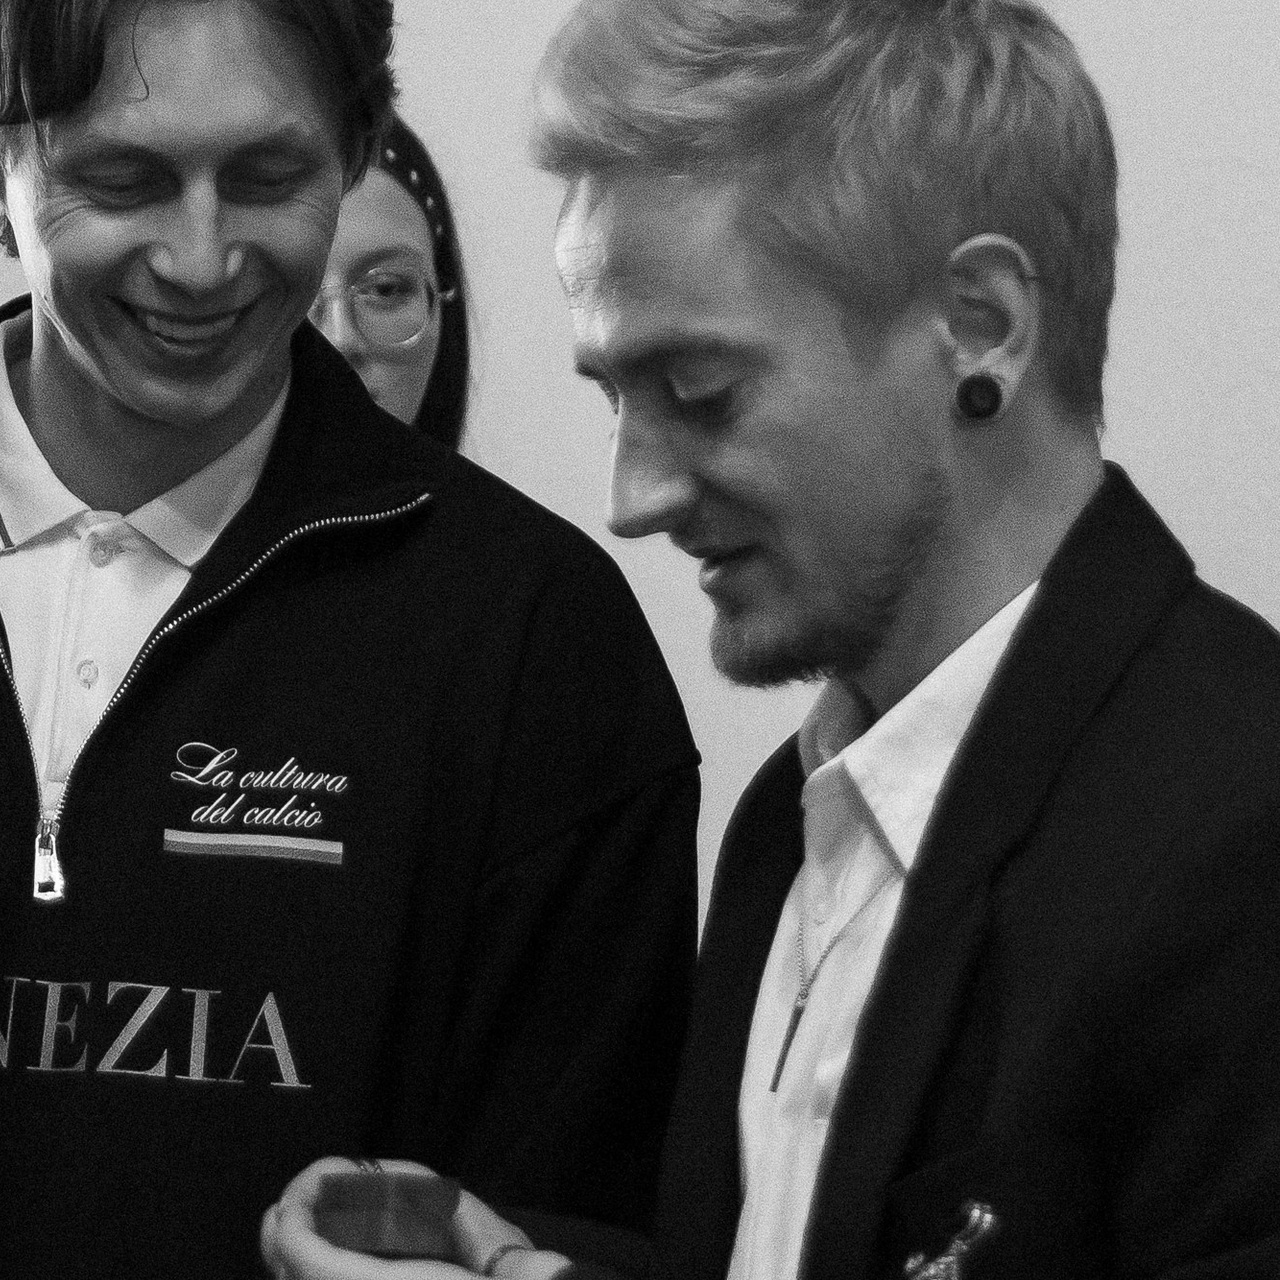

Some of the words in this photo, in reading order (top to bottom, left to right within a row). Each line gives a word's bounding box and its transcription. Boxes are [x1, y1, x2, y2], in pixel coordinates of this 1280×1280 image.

[170, 741, 237, 788] La
[239, 756, 348, 793] cultura
[191, 792, 246, 824] del
[243, 794, 323, 828] calcio
